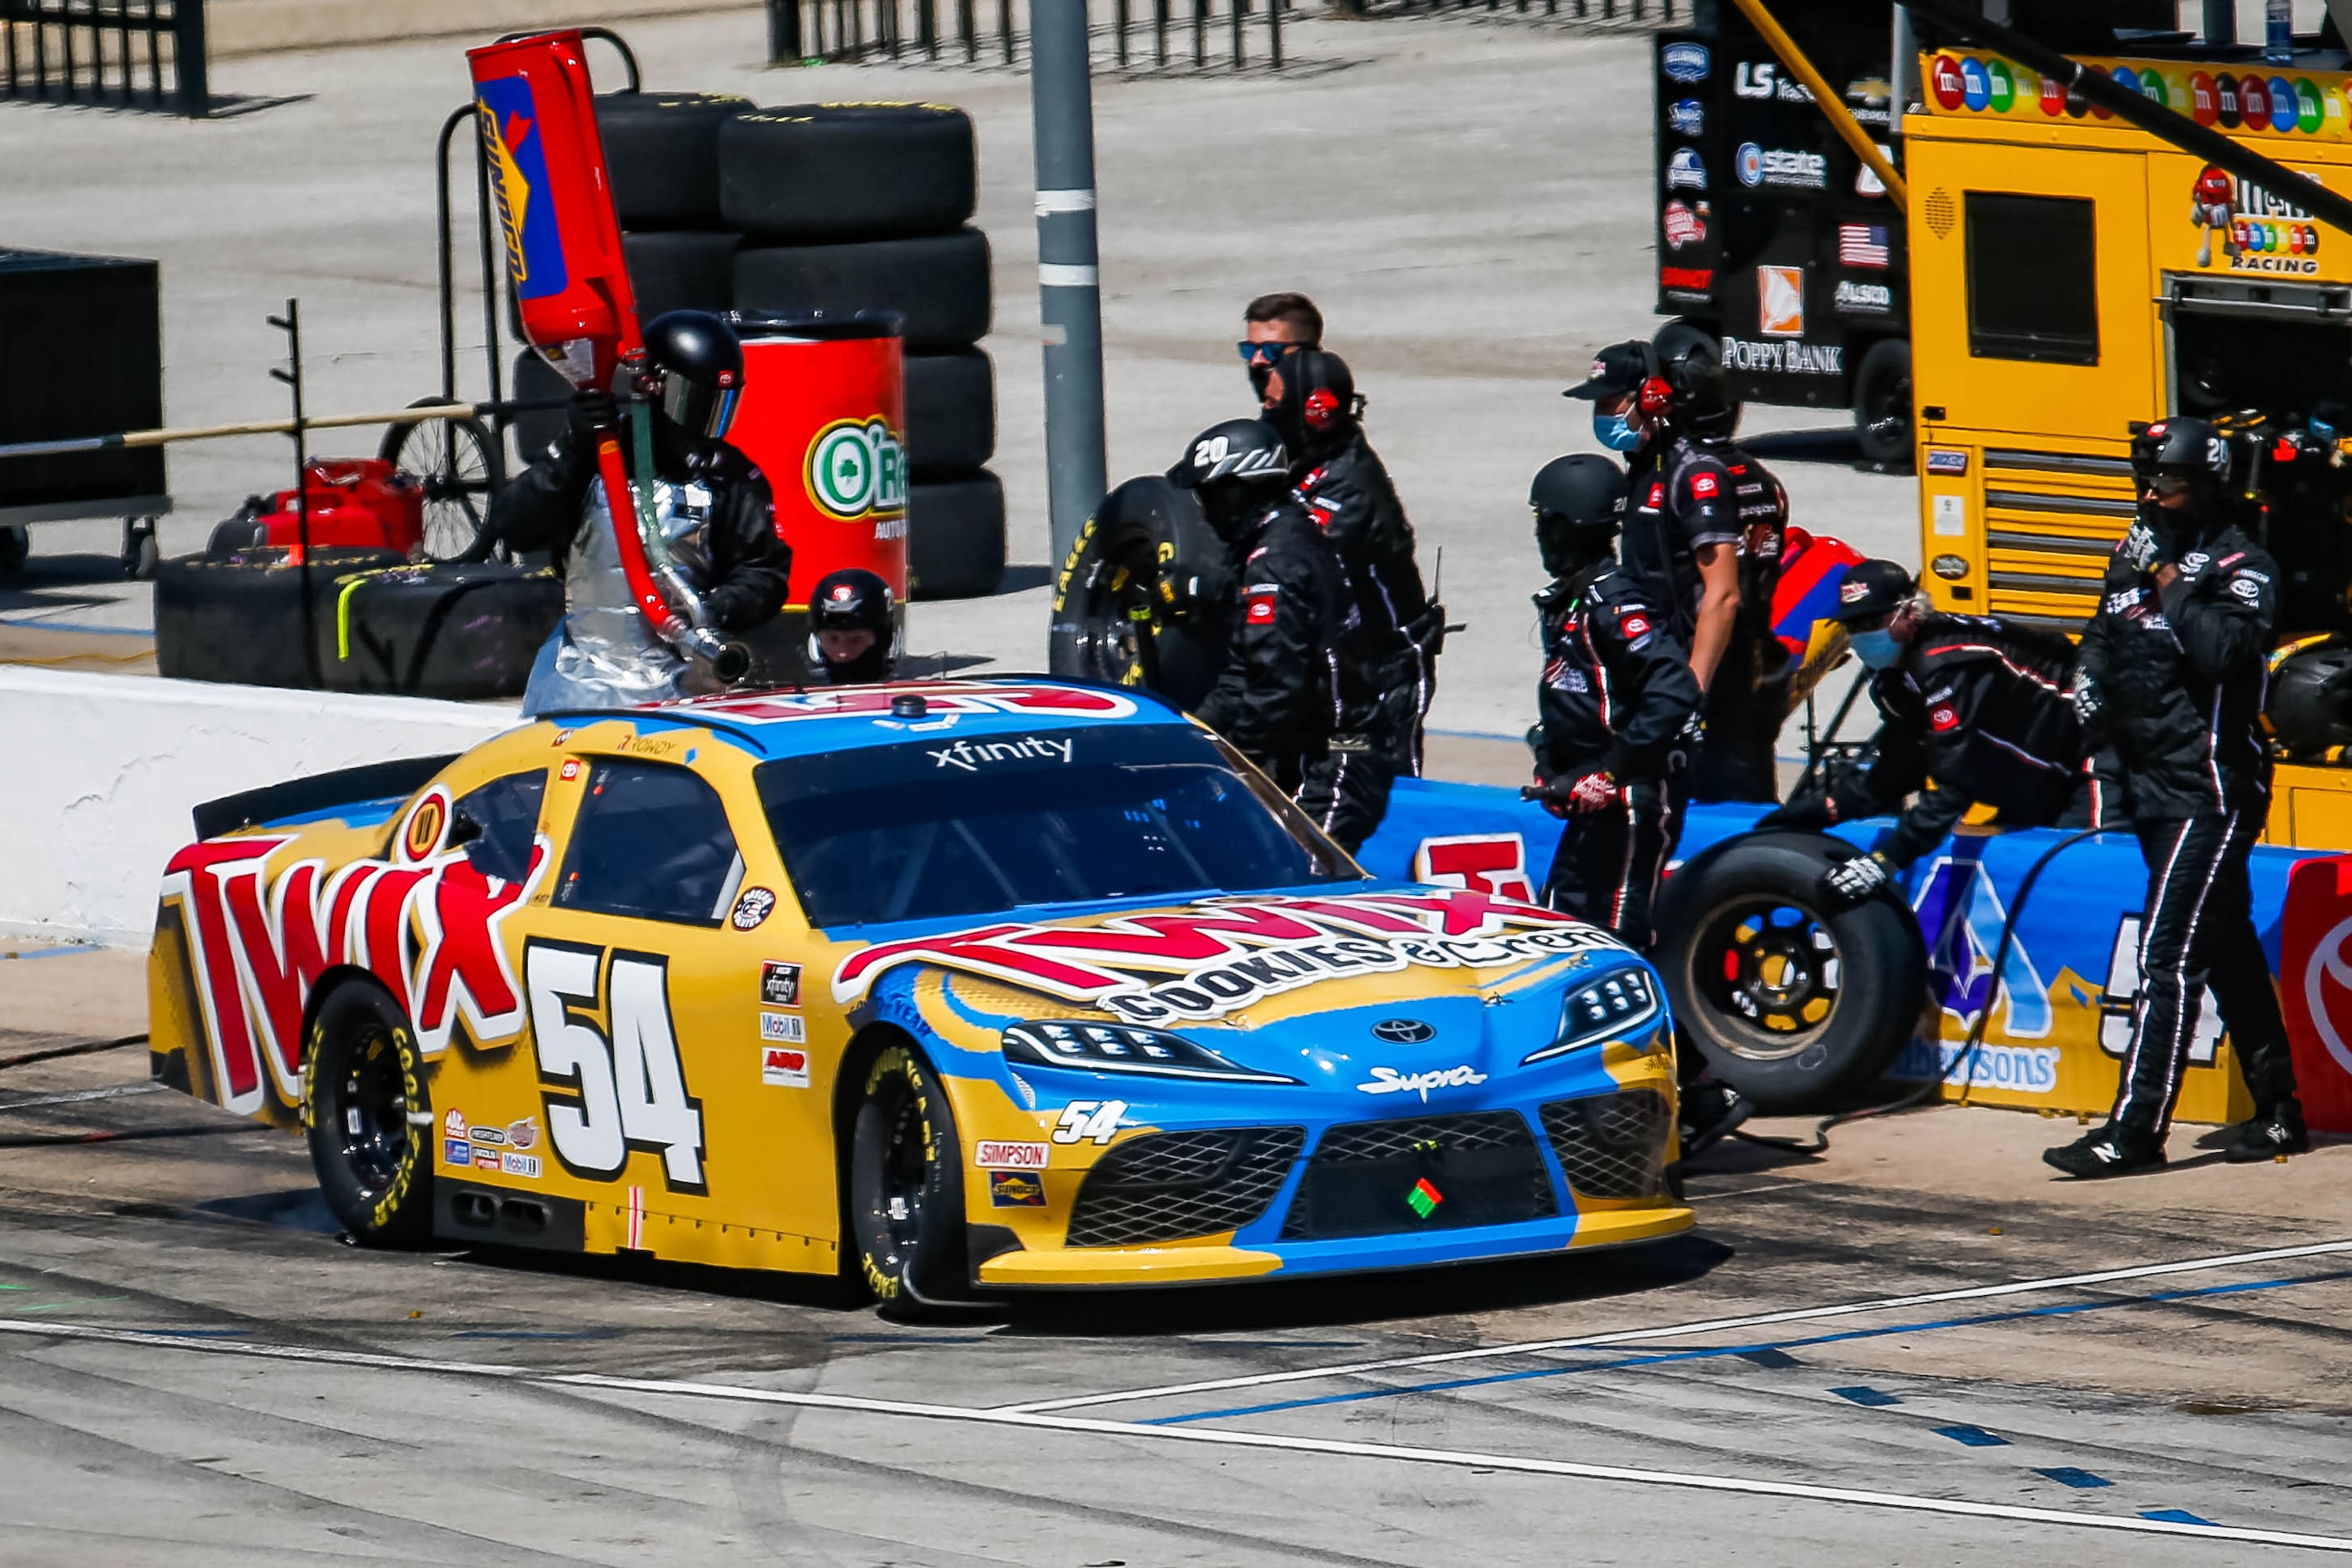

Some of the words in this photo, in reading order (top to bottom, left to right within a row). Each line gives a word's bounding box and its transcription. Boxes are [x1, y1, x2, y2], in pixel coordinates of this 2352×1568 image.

[1735, 61, 1778, 99] LS
[2231, 255, 2318, 274] RACING
[1722, 336, 1784, 372] POPPY
[1784, 339, 1843, 375] BANK
[1194, 435, 1229, 468] 20
[2207, 438, 2229, 463] 20
[926, 736, 1074, 772] xfinity
[1109, 938, 1397, 1024] COOKIES
[1401, 941, 1446, 964] &
[763, 1014, 790, 1035] Mobil
[526, 937, 708, 1196] 54
[1356, 1065, 1488, 1104] Supra
[1051, 1100, 1130, 1146] 54
[504, 1154, 527, 1171] Mobil
[981, 1143, 1044, 1165] SIMPSON
[993, 1183, 1041, 1196] SUNOCO
